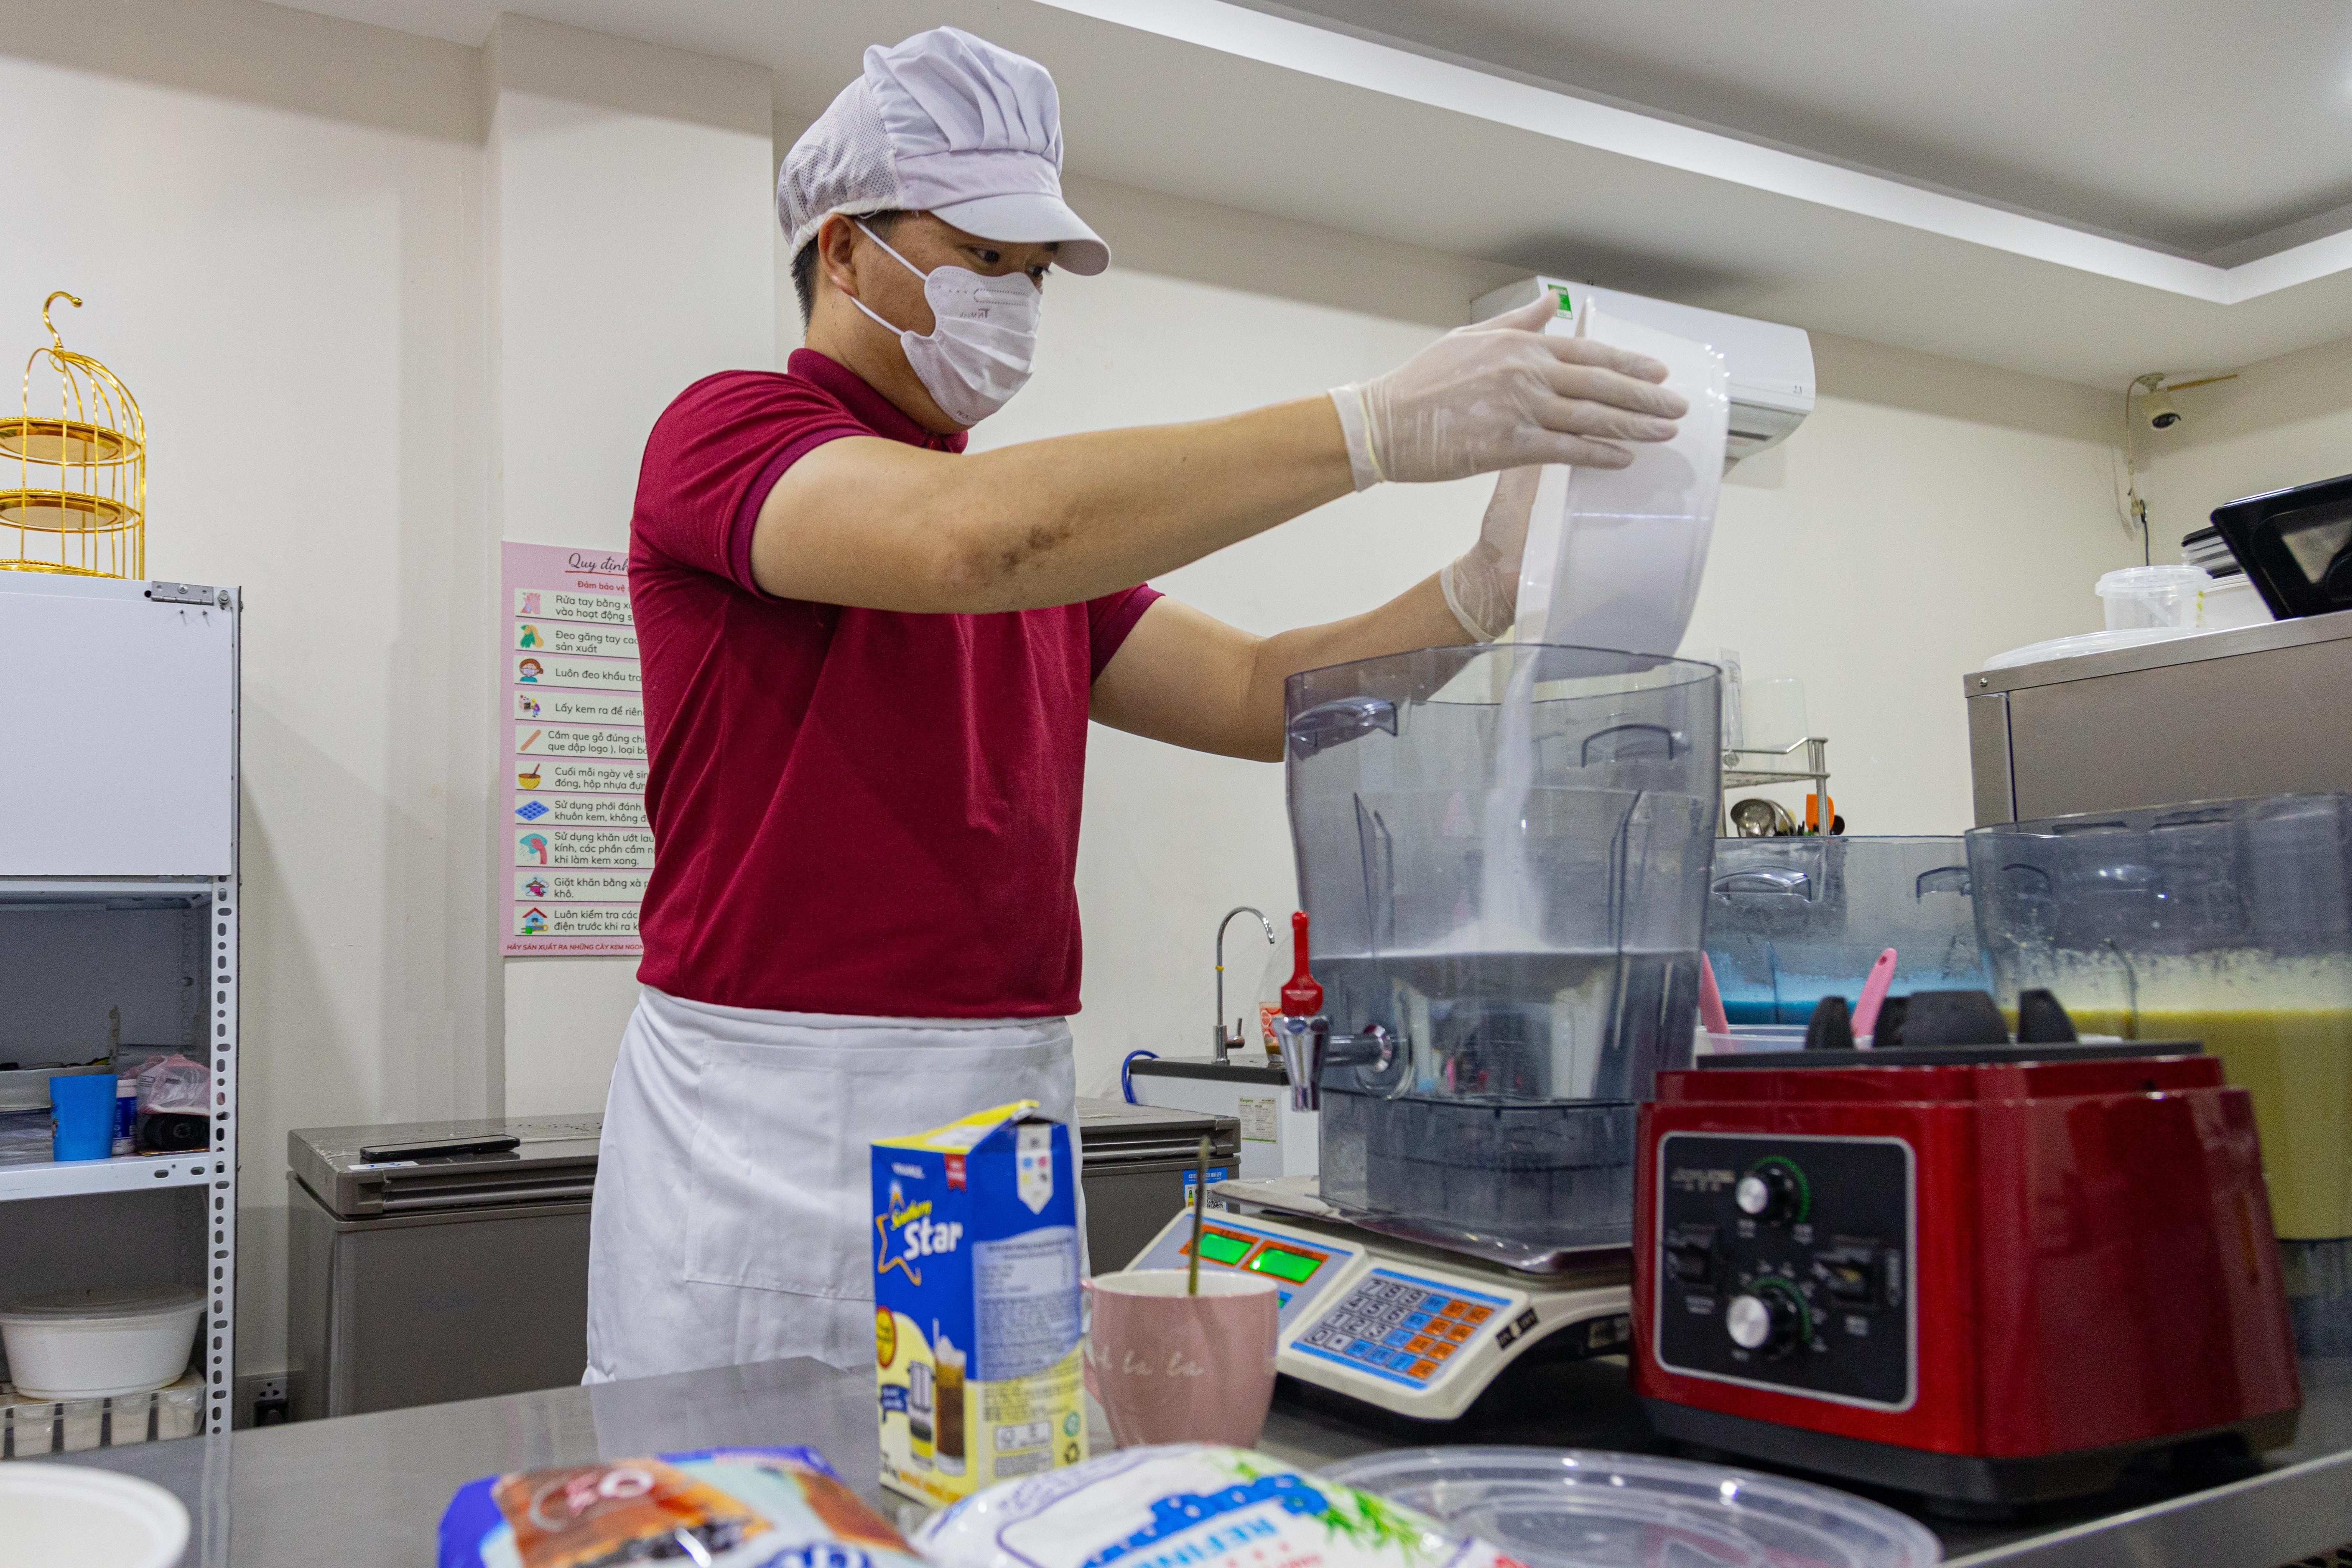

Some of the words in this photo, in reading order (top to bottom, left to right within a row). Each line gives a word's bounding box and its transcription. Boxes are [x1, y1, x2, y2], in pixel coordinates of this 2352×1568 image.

[569, 552, 596, 573] Quy
[600, 556, 628, 572] định
[616, 584, 625, 593] vệ
[556, 595, 575, 605] Rửa
[578, 598, 593, 608] tay
[596, 598, 620, 610] bằng
[556, 607, 573, 616] vào
[577, 608, 598, 619] hoạt
[601, 611, 624, 622] động
[556, 630, 575, 640] Đeo
[578, 633, 602, 643] găng
[606, 635, 620, 645] tay
[556, 642, 573, 651] sản
[576, 644, 597, 653] xuất
[556, 668, 578, 677] Luôn
[582, 670, 599, 679] đeo
[555, 703, 573, 714] Lấy
[576, 704, 595, 713] kem
[611, 706, 623, 715] để
[592, 732, 603, 743] gỗ
[606, 733, 629, 744] đúng
[548, 744, 565, 752] que
[568, 743, 585, 753] dập
[589, 743, 608, 754] logo
[619, 745, 634, 755] loại
[555, 767, 575, 776] Cuối
[578, 767, 595, 777] mỗi
[598, 769, 620, 779] ngày
[623, 770, 634, 781] vệ
[584, 779, 601, 790] hộp
[603, 781, 626, 791] nhựa
[555, 800, 567, 809] Sử
[570, 801, 593, 812] dụng
[619, 802, 641, 811] đánh
[555, 812, 583, 821] khuôn
[586, 813, 607, 822] kem,
[610, 813, 638, 824] không
[555, 832, 567, 841] Sử
[570, 832, 594, 843] dụng
[597, 833, 620, 842] khăn
[623, 834, 638, 843] ướt
[641, 834, 654, 843] lau
[555, 843, 577, 853] kính,
[579, 844, 596, 853] các
[555, 855, 568, 864] khi
[571, 855, 588, 864] làm
[592, 856, 611, 865] kem
[614, 858, 639, 867] xong.
[554, 878, 574, 888] Giặt
[577, 878, 600, 887] khăn
[603, 878, 627, 889] bằng
[630, 879, 641, 887] xà
[554, 889, 574, 898] khô.
[554, 910, 578, 919] Luôn
[581, 909, 603, 919] kiểm
[622, 910, 638, 919] các
[554, 922, 574, 932] điện
[605, 922, 618, 930] khi
